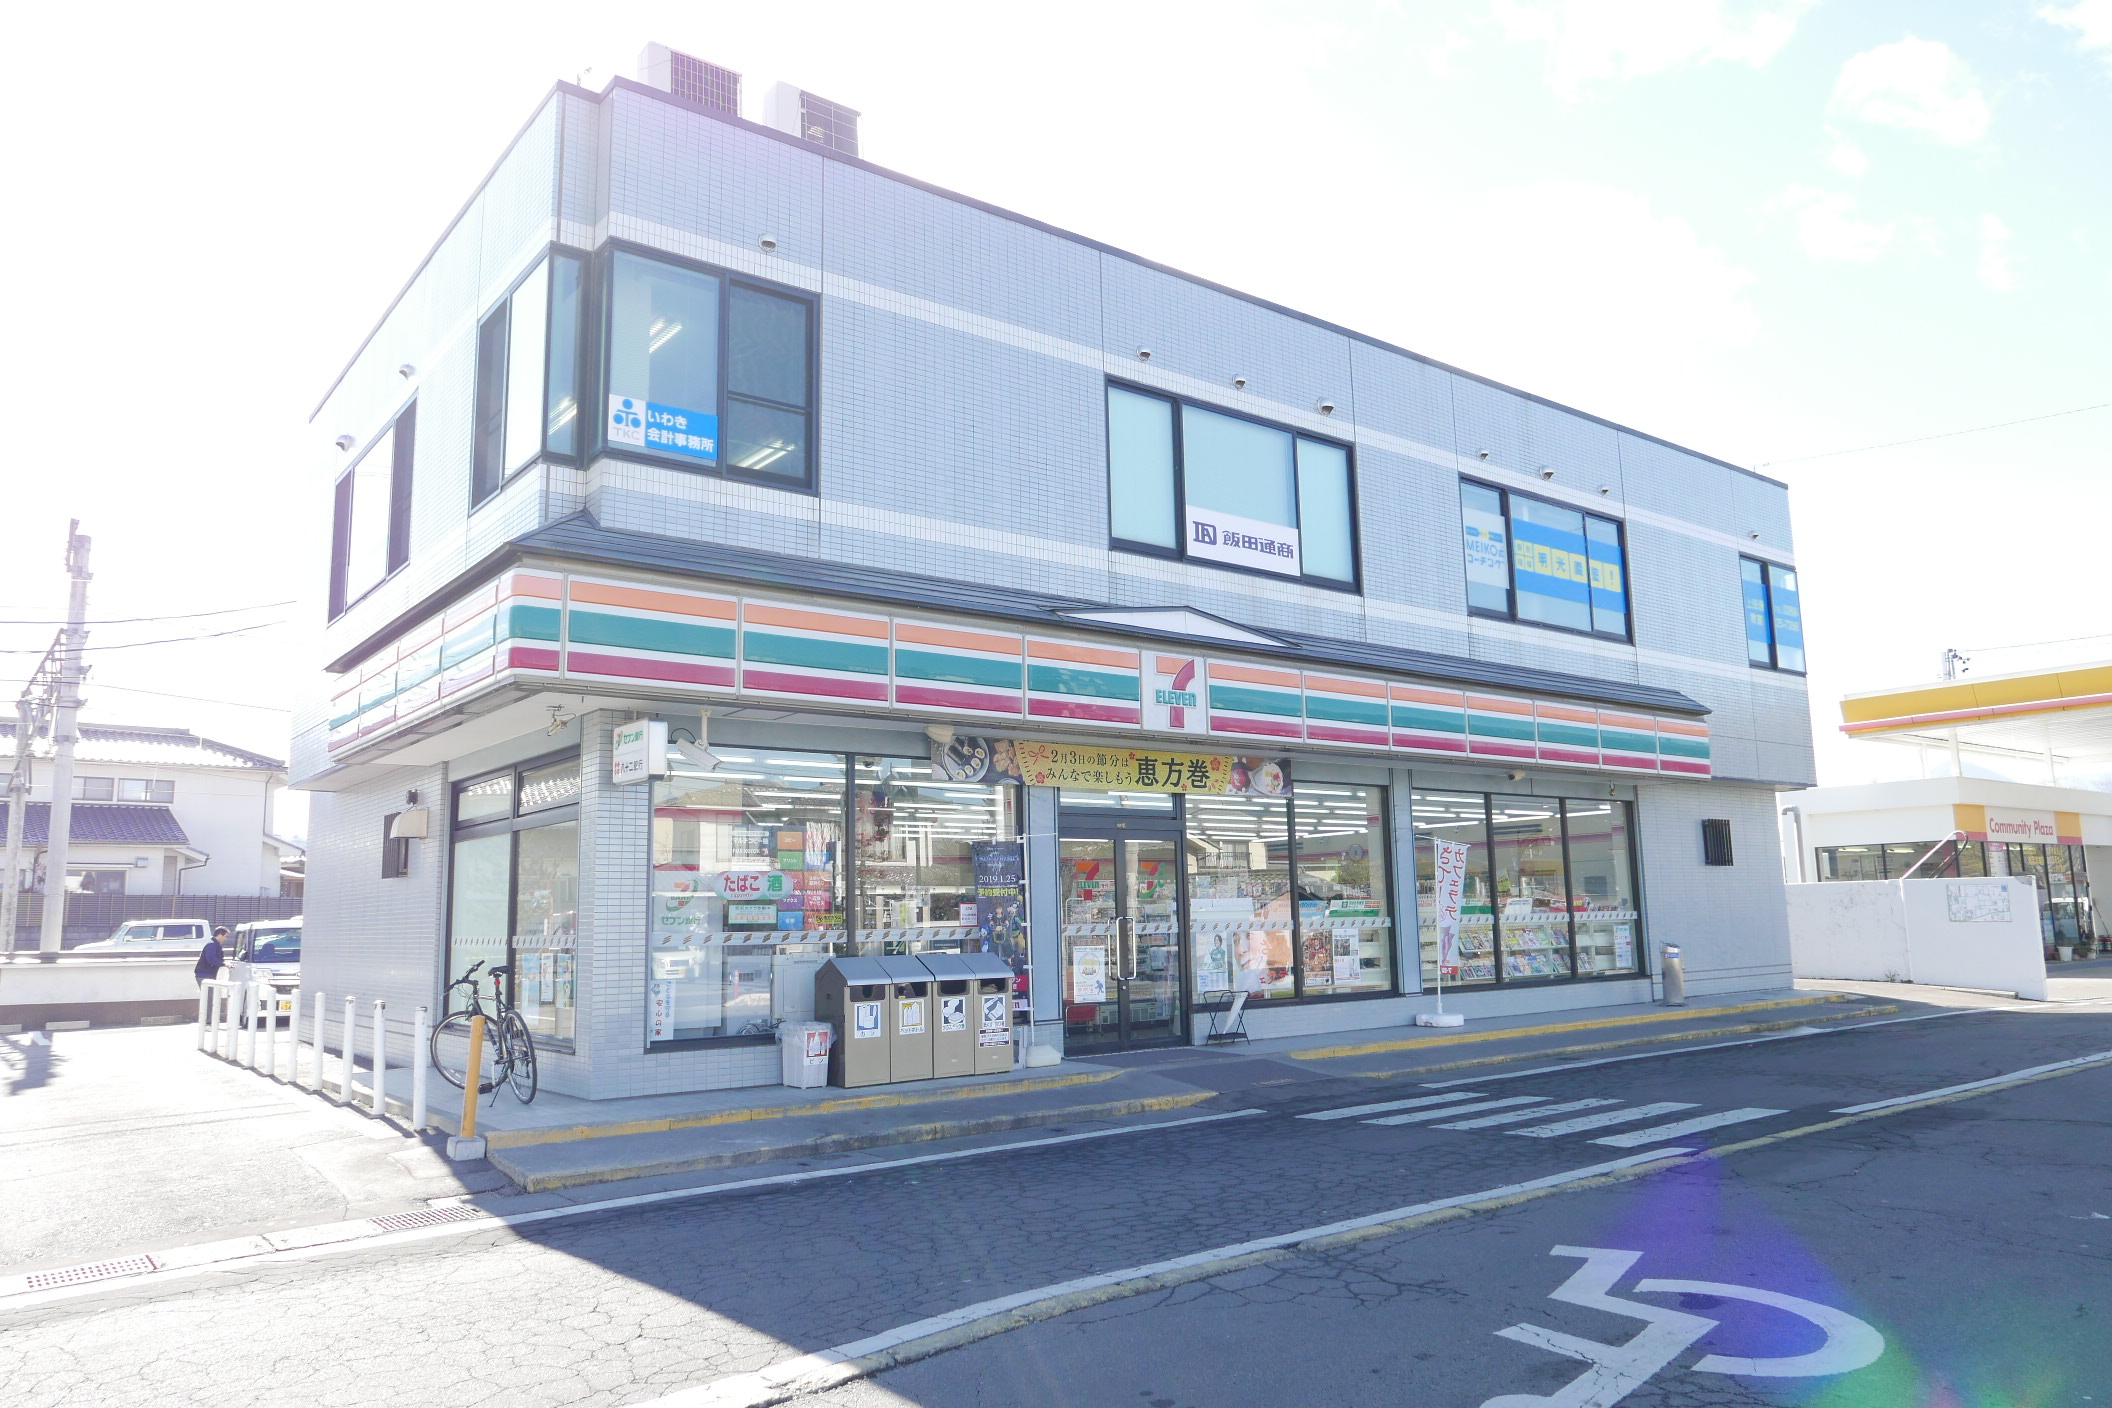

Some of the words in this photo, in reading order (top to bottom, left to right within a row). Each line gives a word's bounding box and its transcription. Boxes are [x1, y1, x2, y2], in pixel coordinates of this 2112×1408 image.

[647, 409, 687, 429] いわき
[613, 427, 640, 440] TKC
[647, 427, 714, 453] 会計事務所
[1222, 530, 1294, 559] 飯田通商
[1050, 749, 1130, 768] 2月3日の節分は
[1046, 767, 1133, 786] みんなで楽しもう
[1135, 757, 1211, 789] 恵方巻
[1989, 817, 2032, 838] Community
[2033, 820, 2054, 836] Plaza
[723, 875, 760, 892] たばこ
[767, 875, 783, 892] 酒
[979, 875, 1016, 883] 2019.1.25
[977, 887, 1019, 897] 予約受付中!
